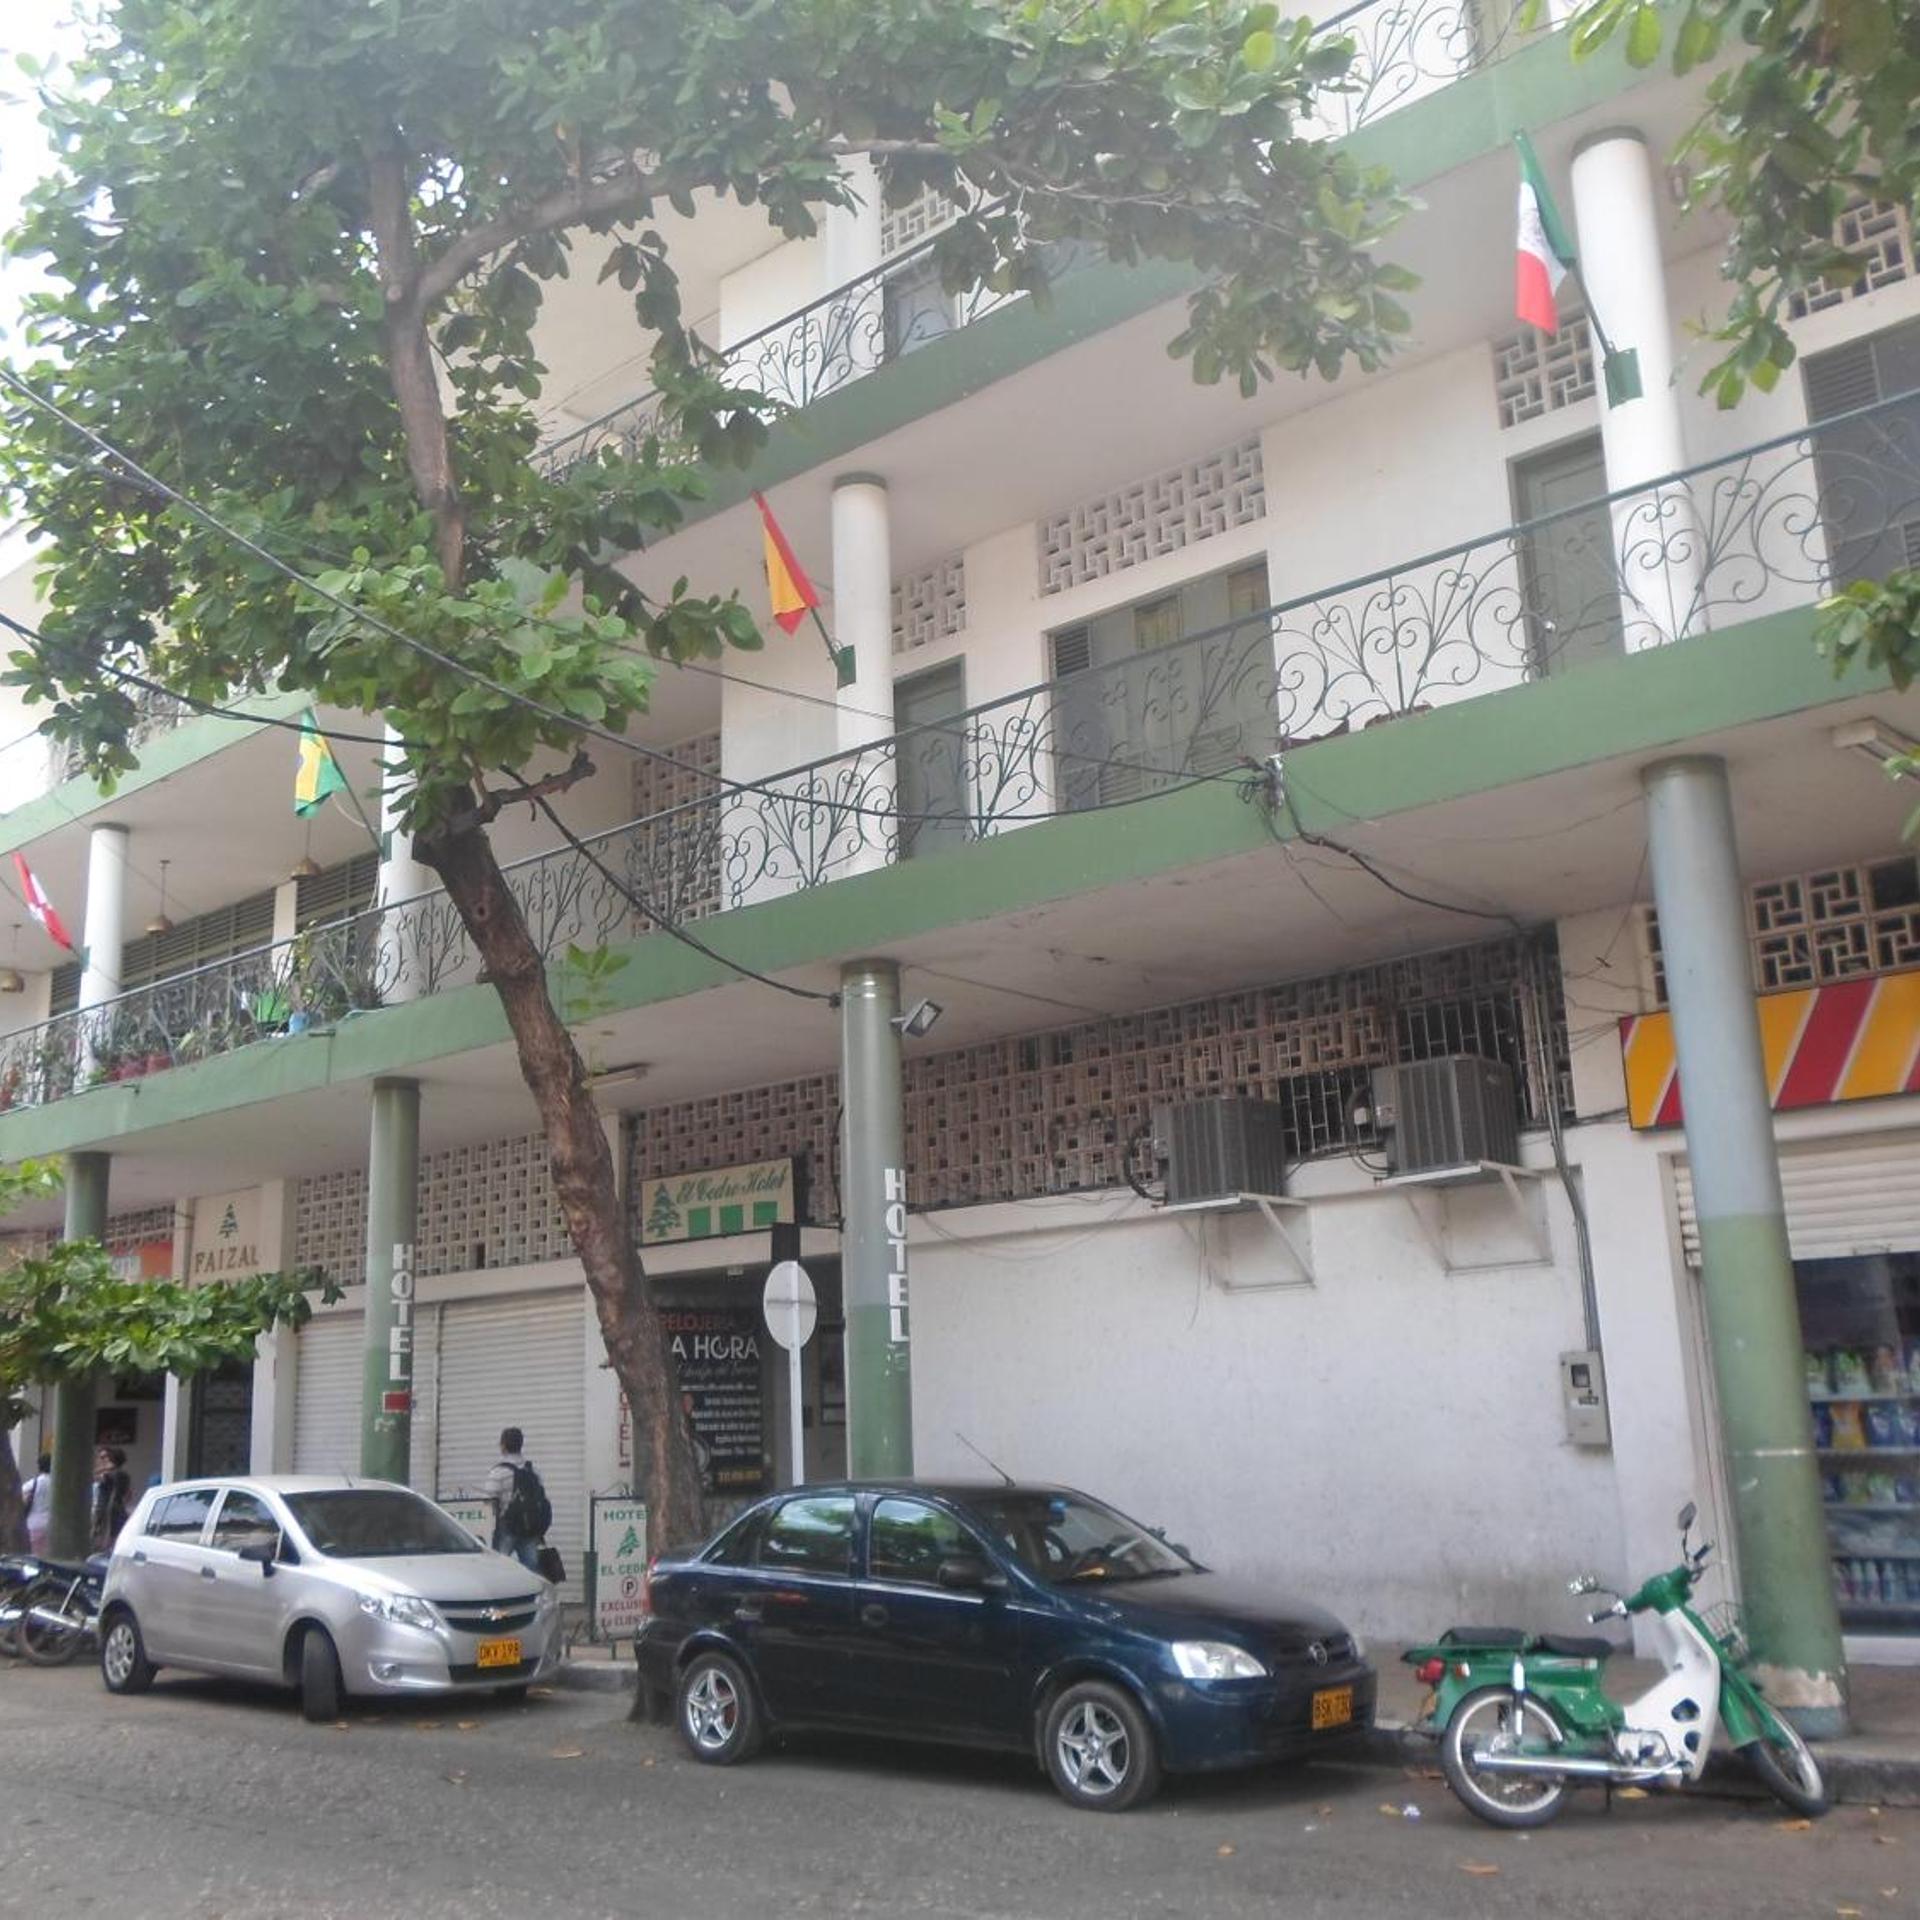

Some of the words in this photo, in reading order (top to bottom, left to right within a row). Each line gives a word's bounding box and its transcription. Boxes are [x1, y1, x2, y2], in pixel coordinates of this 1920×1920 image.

[740, 1164, 789, 1195] Hotel
[195, 1244, 260, 1273] FAIZAL
[884, 1168, 909, 1342] HOTEL
[389, 1243, 414, 1380] HOTEL
[693, 1334, 760, 1359] HORA
[619, 1390, 633, 1459] OTEL
[603, 1509, 648, 1521] HOTE
